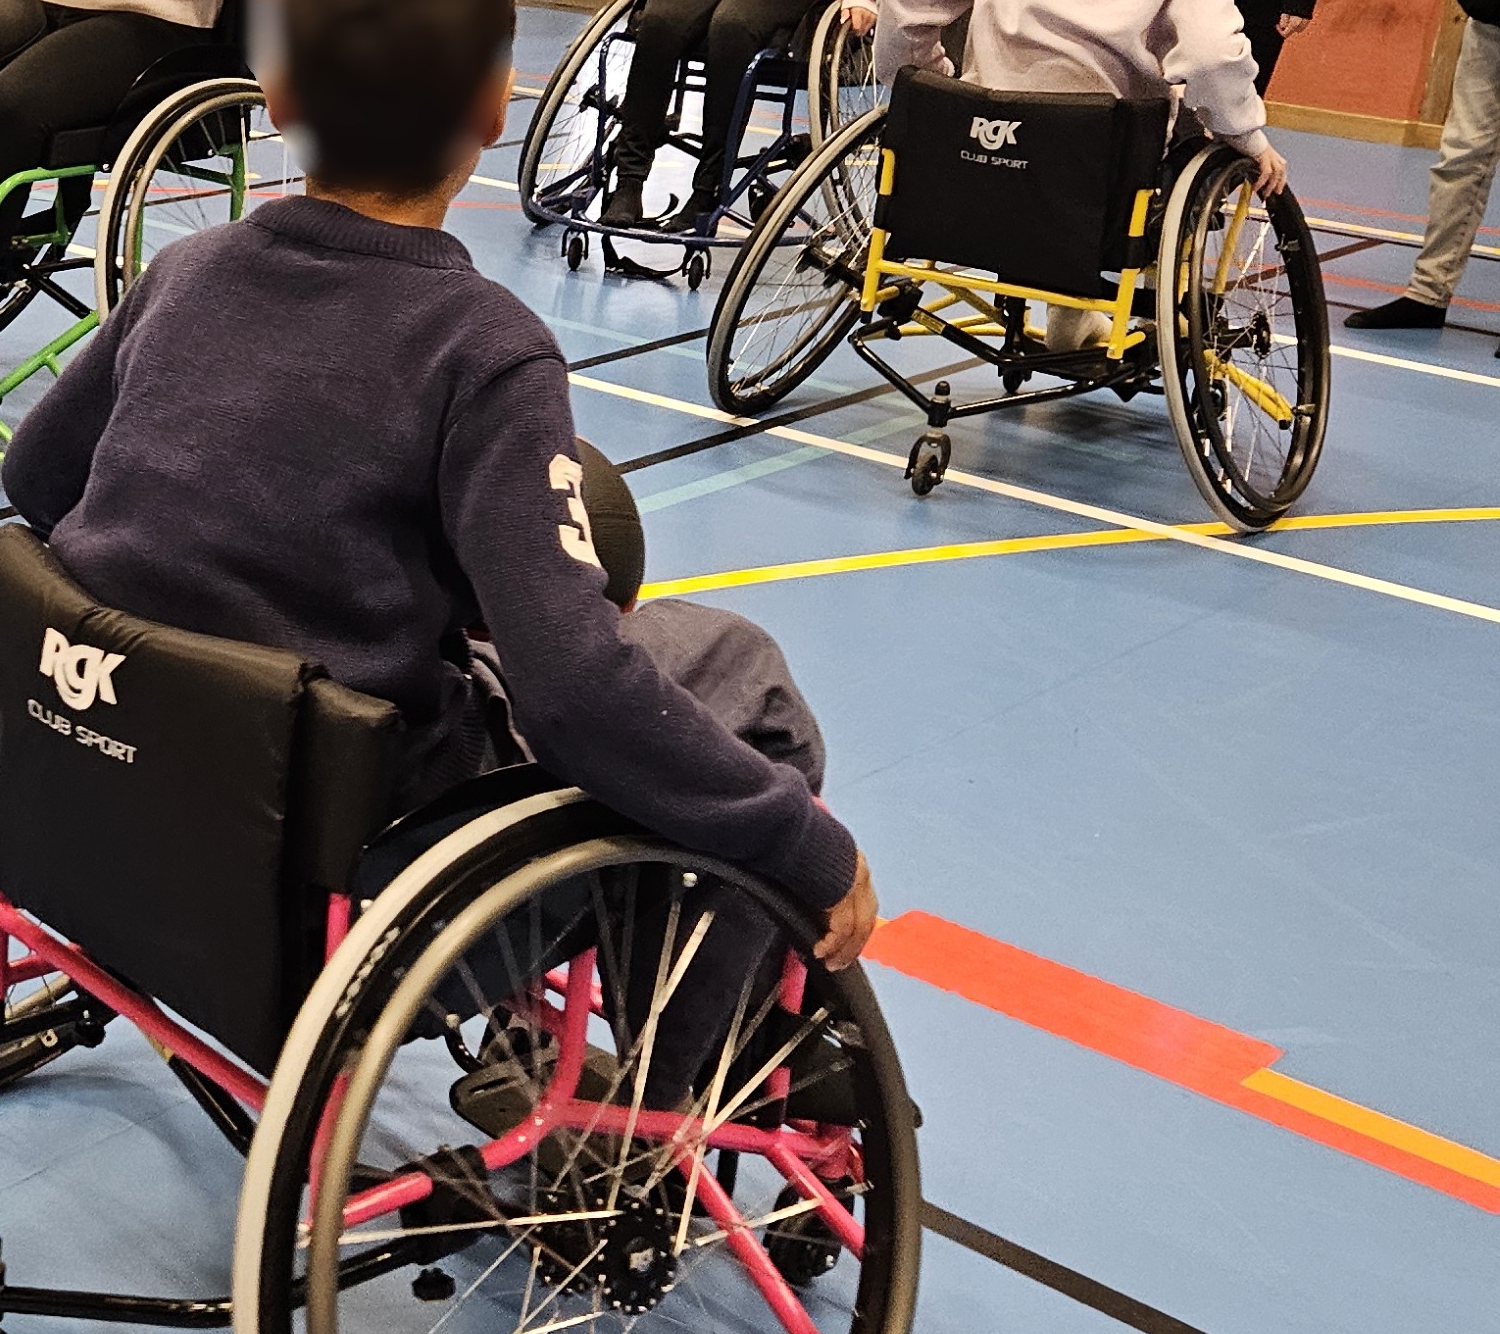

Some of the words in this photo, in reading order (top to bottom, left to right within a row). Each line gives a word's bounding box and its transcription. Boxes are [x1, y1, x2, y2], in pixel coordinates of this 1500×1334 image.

[970, 116, 1022, 151] RGK
[960, 150, 987, 164] CLUB
[991, 156, 1029, 169] SPORT
[39, 627, 127, 711] RGK
[27, 698, 72, 736] CLUB
[75, 725, 137, 764] SPORT
